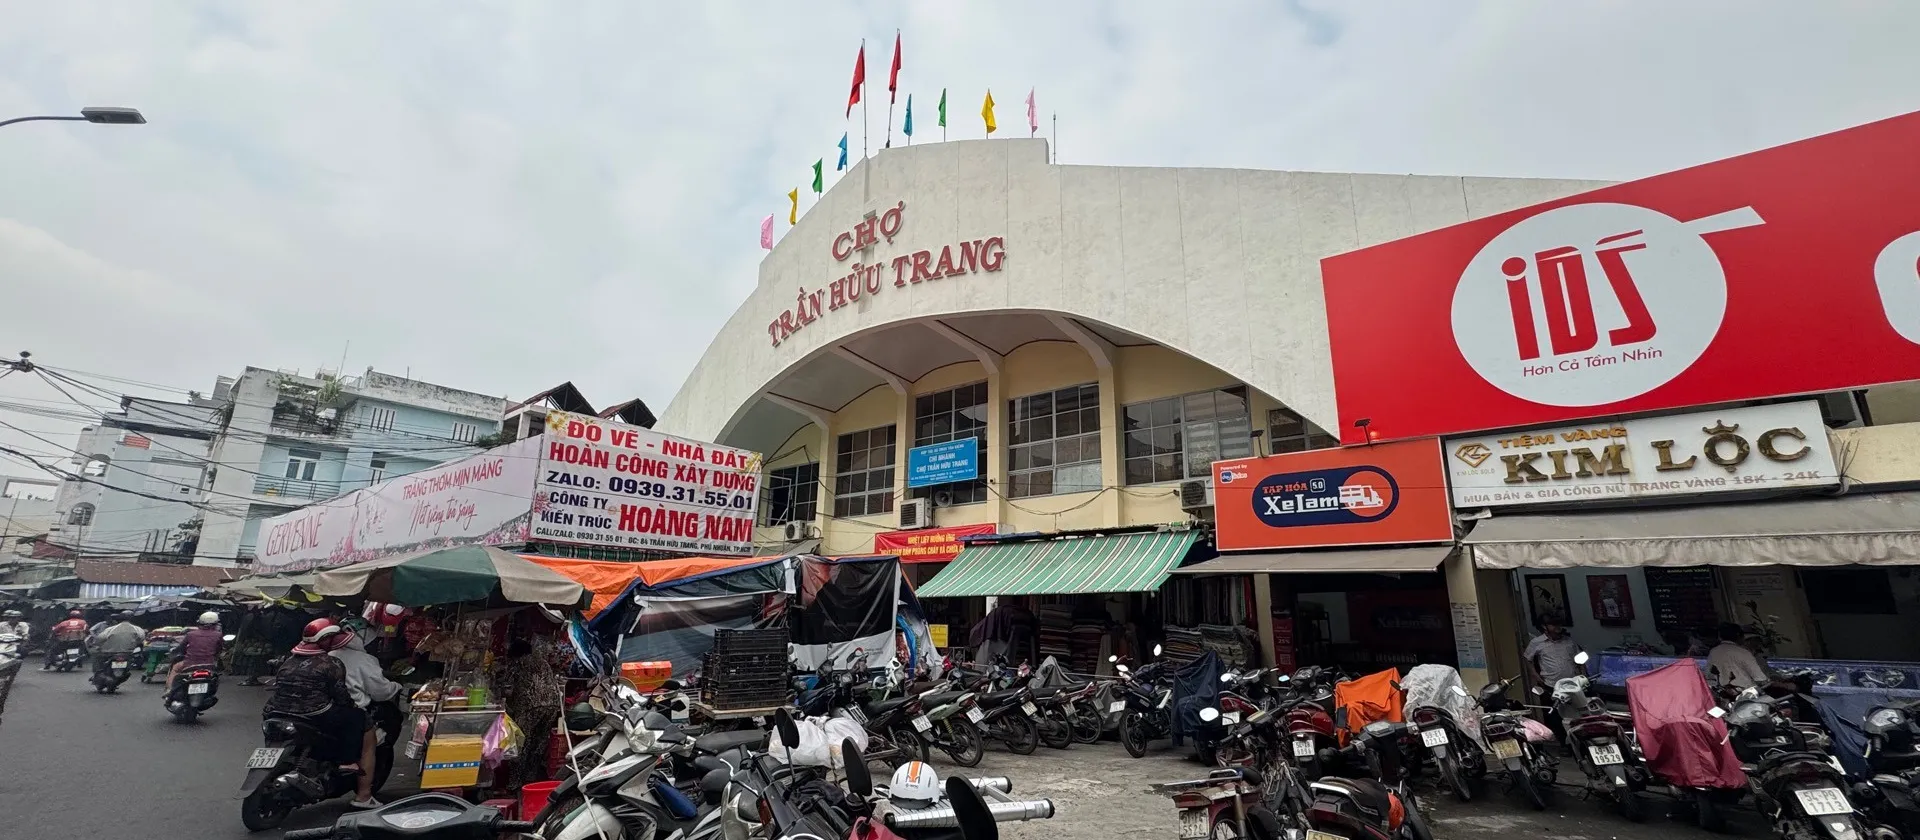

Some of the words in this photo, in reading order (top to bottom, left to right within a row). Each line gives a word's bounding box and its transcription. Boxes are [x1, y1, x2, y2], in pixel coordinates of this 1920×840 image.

[832, 200, 906, 261] CHỢ
[767, 286, 825, 348] TRẦN
[828, 262, 883, 311] HỮU
[892, 237, 1006, 288] TRANG
[1523, 365, 1553, 377] Hơn
[1558, 358, 1580, 372] Cả
[1584, 353, 1617, 367] Tầm
[1623, 346, 1663, 362] Nhìn
[567, 420, 602, 442] ĐO
[610, 429, 639, 449] VẼ
[662, 439, 705, 462] NHÀ
[711, 449, 748, 469] ĐẤT
[1497, 435, 1554, 449] TIỆM
[1560, 426, 1627, 442] VÀNG
[1500, 444, 1631, 484] KIM
[1651, 419, 1812, 473] LỘC
[472, 458, 503, 482] MÀNG
[549, 441, 610, 469] HOÀN
[615, 453, 668, 479] CÔNG
[673, 462, 708, 484] XÂY
[713, 471, 755, 492] DỰNG
[546, 470, 601, 489] ZALO:
[608, 476, 753, 510] 0939.31.55.01
[550, 490, 588, 507] CÔNG
[593, 497, 608, 510] TY
[1262, 485, 1283, 495] TẠP
[1285, 481, 1308, 492] HÓA
[1463, 494, 1490, 503] MUA
[1494, 490, 1520, 501] BÁN
[1524, 490, 1534, 499] &
[1538, 488, 1559, 498] GIA
[1563, 484, 1602, 496] CÔNG
[1630, 480, 1680, 492] TRANG
[1685, 476, 1726, 488] VÀNG
[1733, 473, 1767, 485] 18K
[1784, 470, 1820, 481] 24K
[541, 509, 573, 525] KIẾN
[578, 514, 612, 529] TRÚC
[1263, 494, 1339, 515] XeLam
[576, 532, 594, 540] 0939
[618, 500, 699, 539] HOÀNG
[703, 514, 753, 542] NAM
[1809, 801, 1844, 812] 1713
